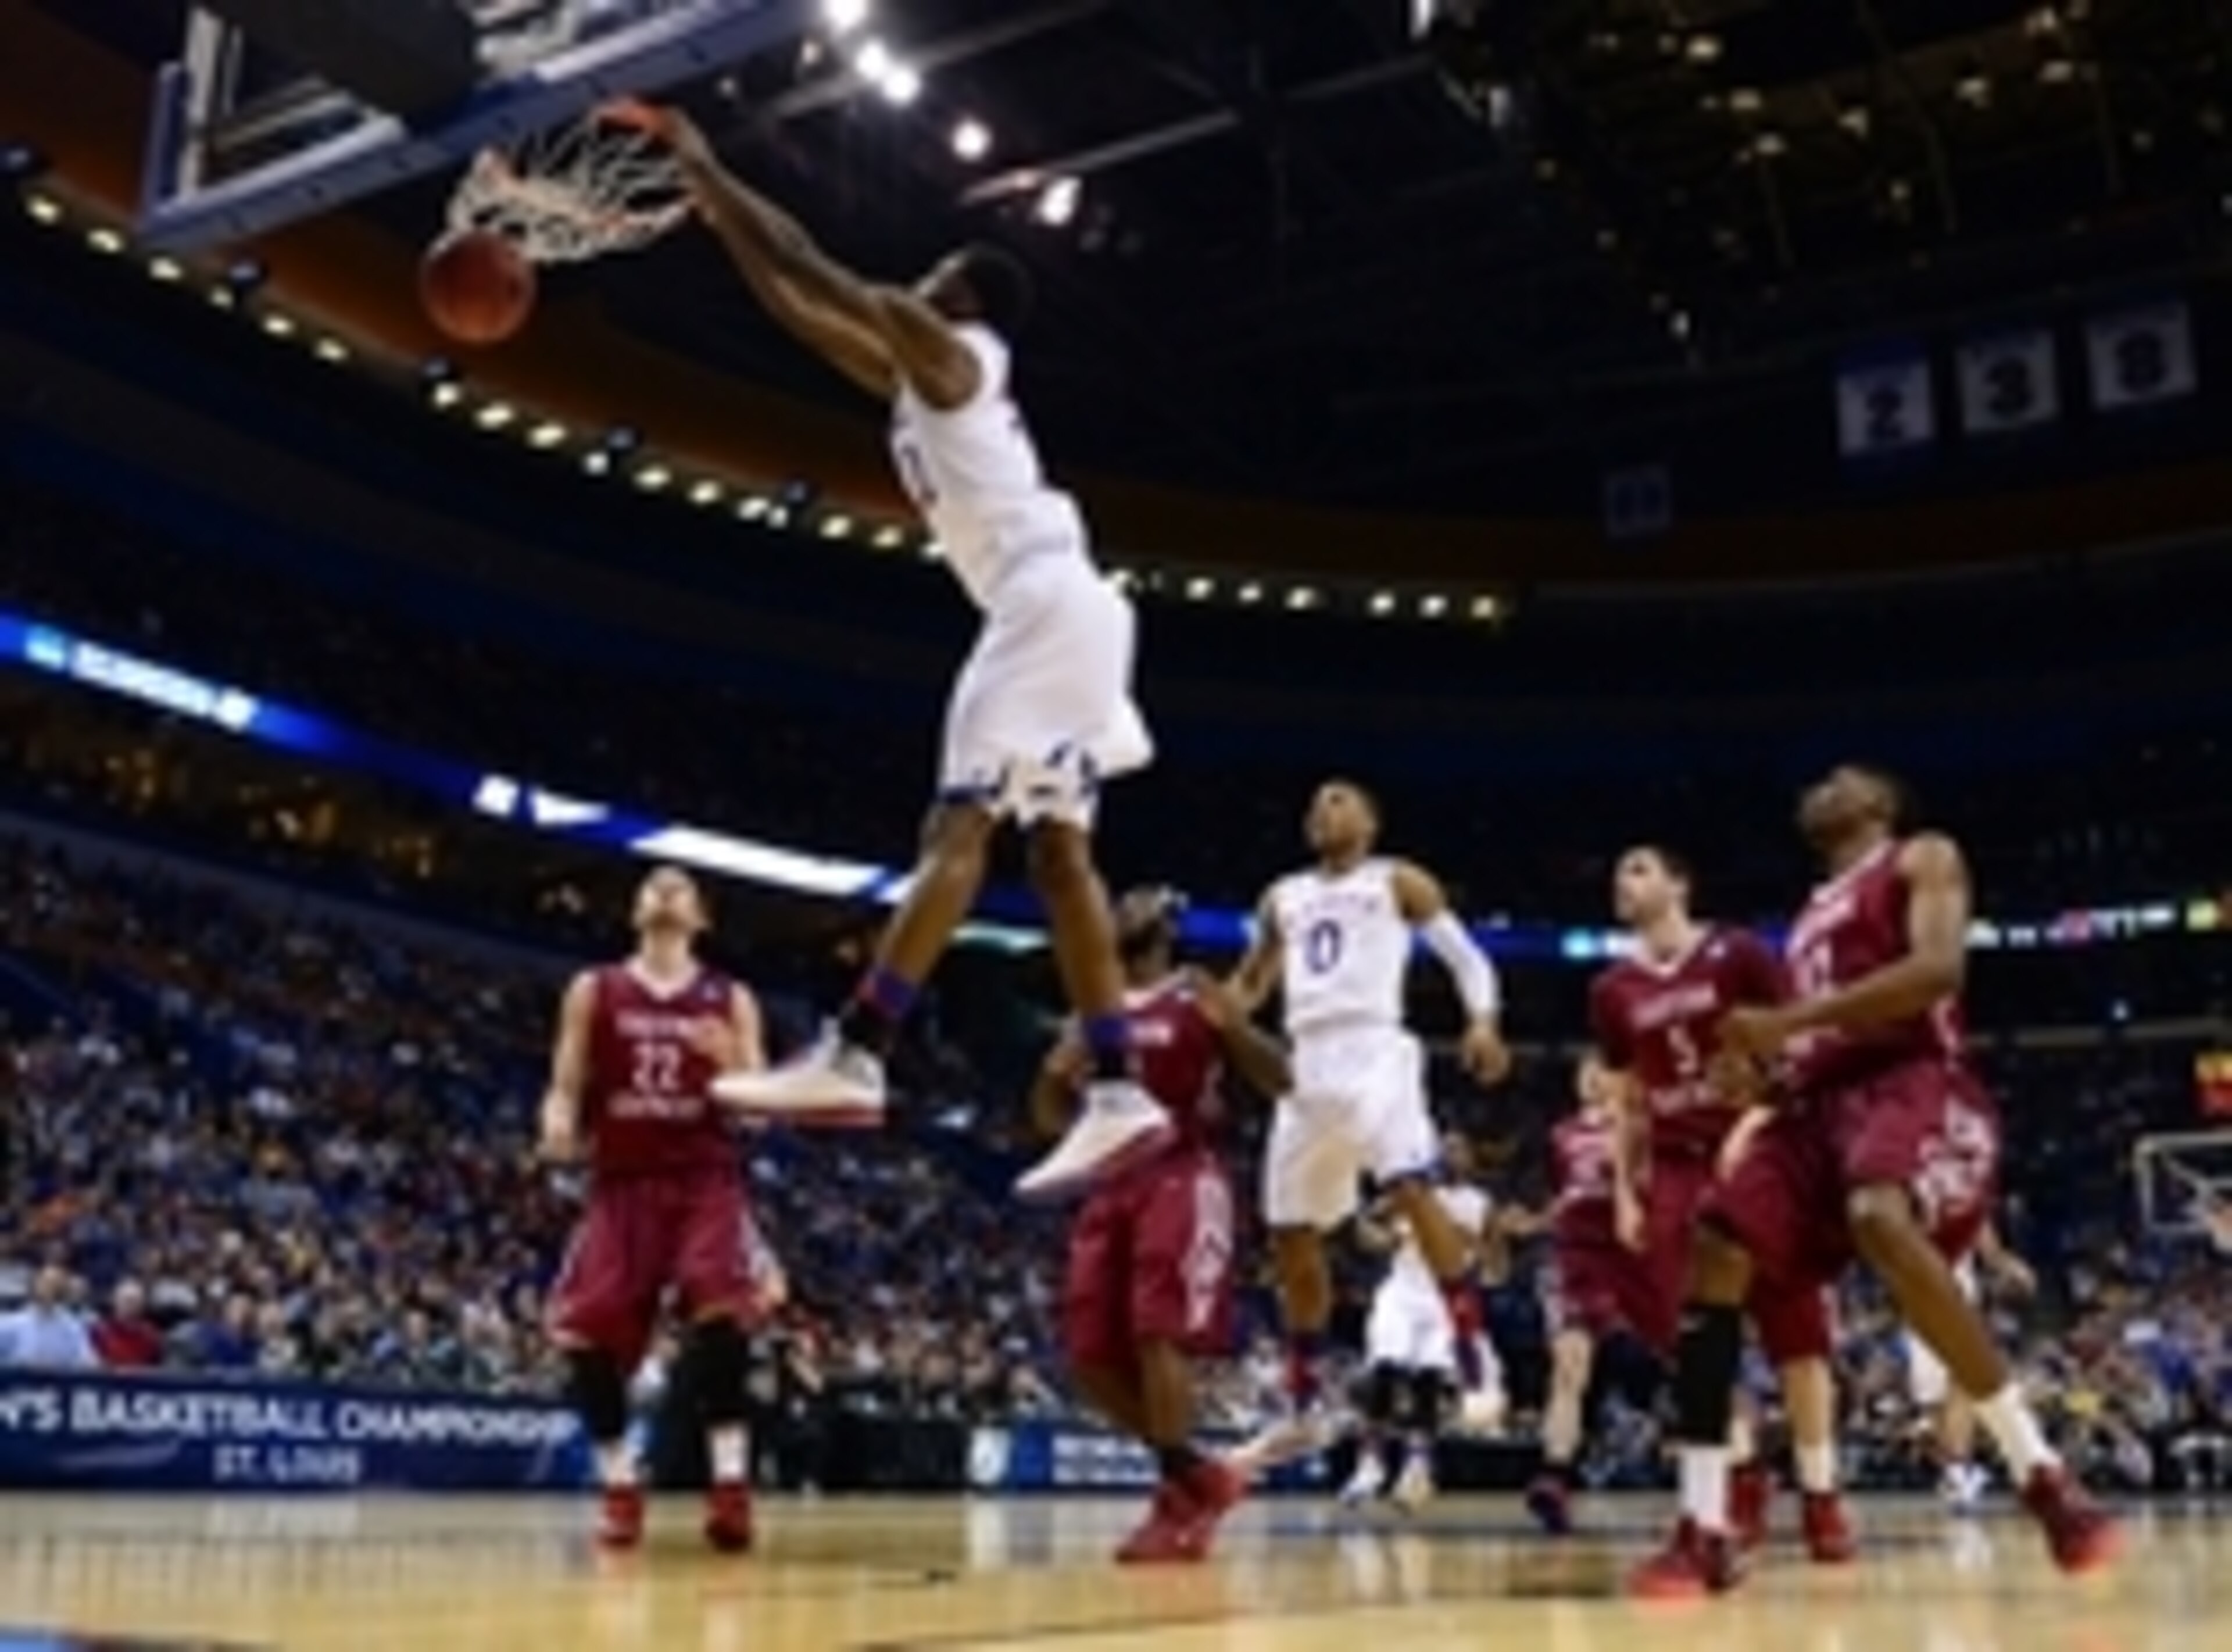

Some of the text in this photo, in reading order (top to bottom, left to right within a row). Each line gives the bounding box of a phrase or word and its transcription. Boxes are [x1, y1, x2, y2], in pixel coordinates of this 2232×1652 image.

[1865, 384, 1905, 441] 2
[1304, 918, 1342, 975] 0
[632, 1042, 681, 1092] 22
[70, 1389, 327, 1439] BASKETBALL
